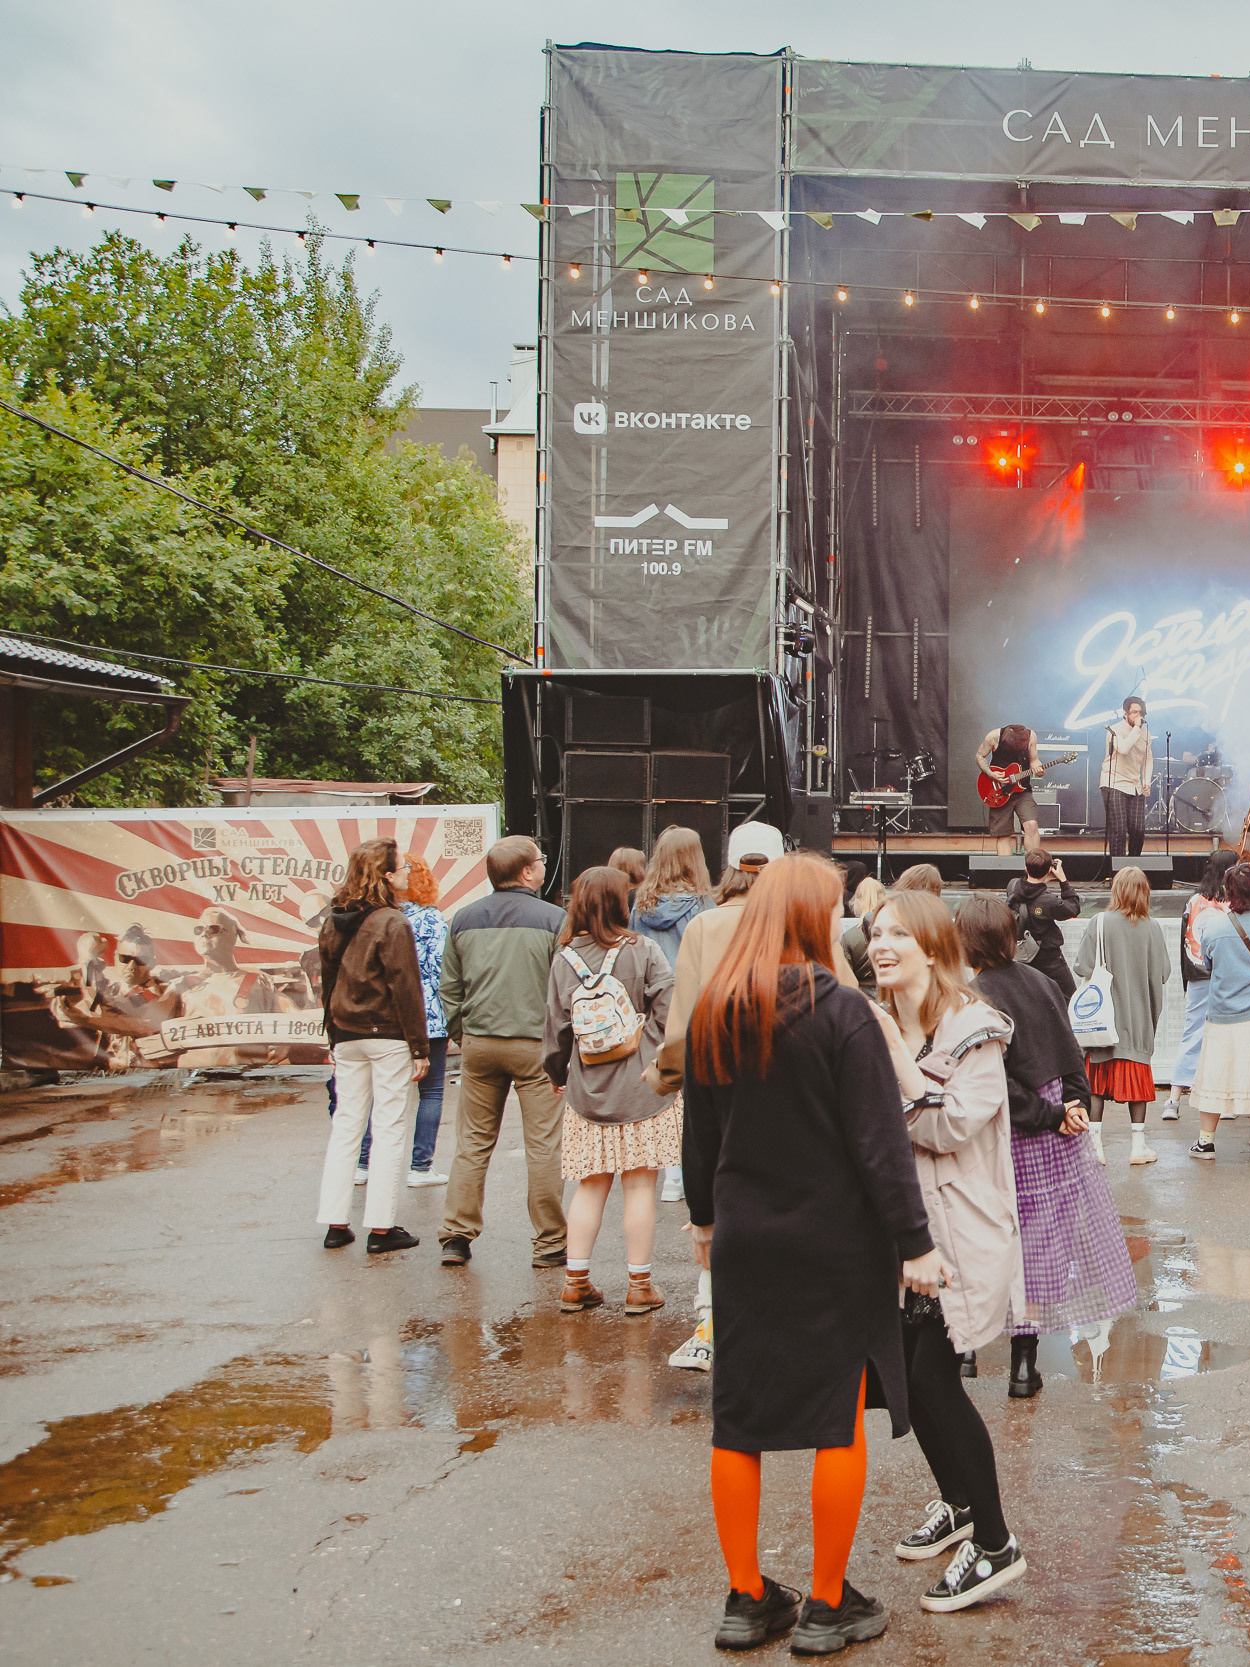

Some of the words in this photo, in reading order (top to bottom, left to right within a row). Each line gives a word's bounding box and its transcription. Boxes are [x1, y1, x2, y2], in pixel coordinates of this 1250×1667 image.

[1001, 109, 1115, 149] САД
[635, 286, 693, 307] САД
[571, 309, 756, 332] МЕНШИКОВА
[609, 538, 678, 555] ПИТЕР
[684, 540, 713, 556] FM
[641, 561, 682, 576] 100.9
[221, 828, 247, 837] САД
[221, 837, 304, 848] МЕНШИКОВА
[117, 857, 231, 900] СКВОРЦЫ
[240, 856, 347, 883] СТЕПАНО
[248, 883, 288, 902] ЛЕТ
[169, 1025, 187, 1042] 27
[196, 1020, 264, 1038] АВГУСТА
